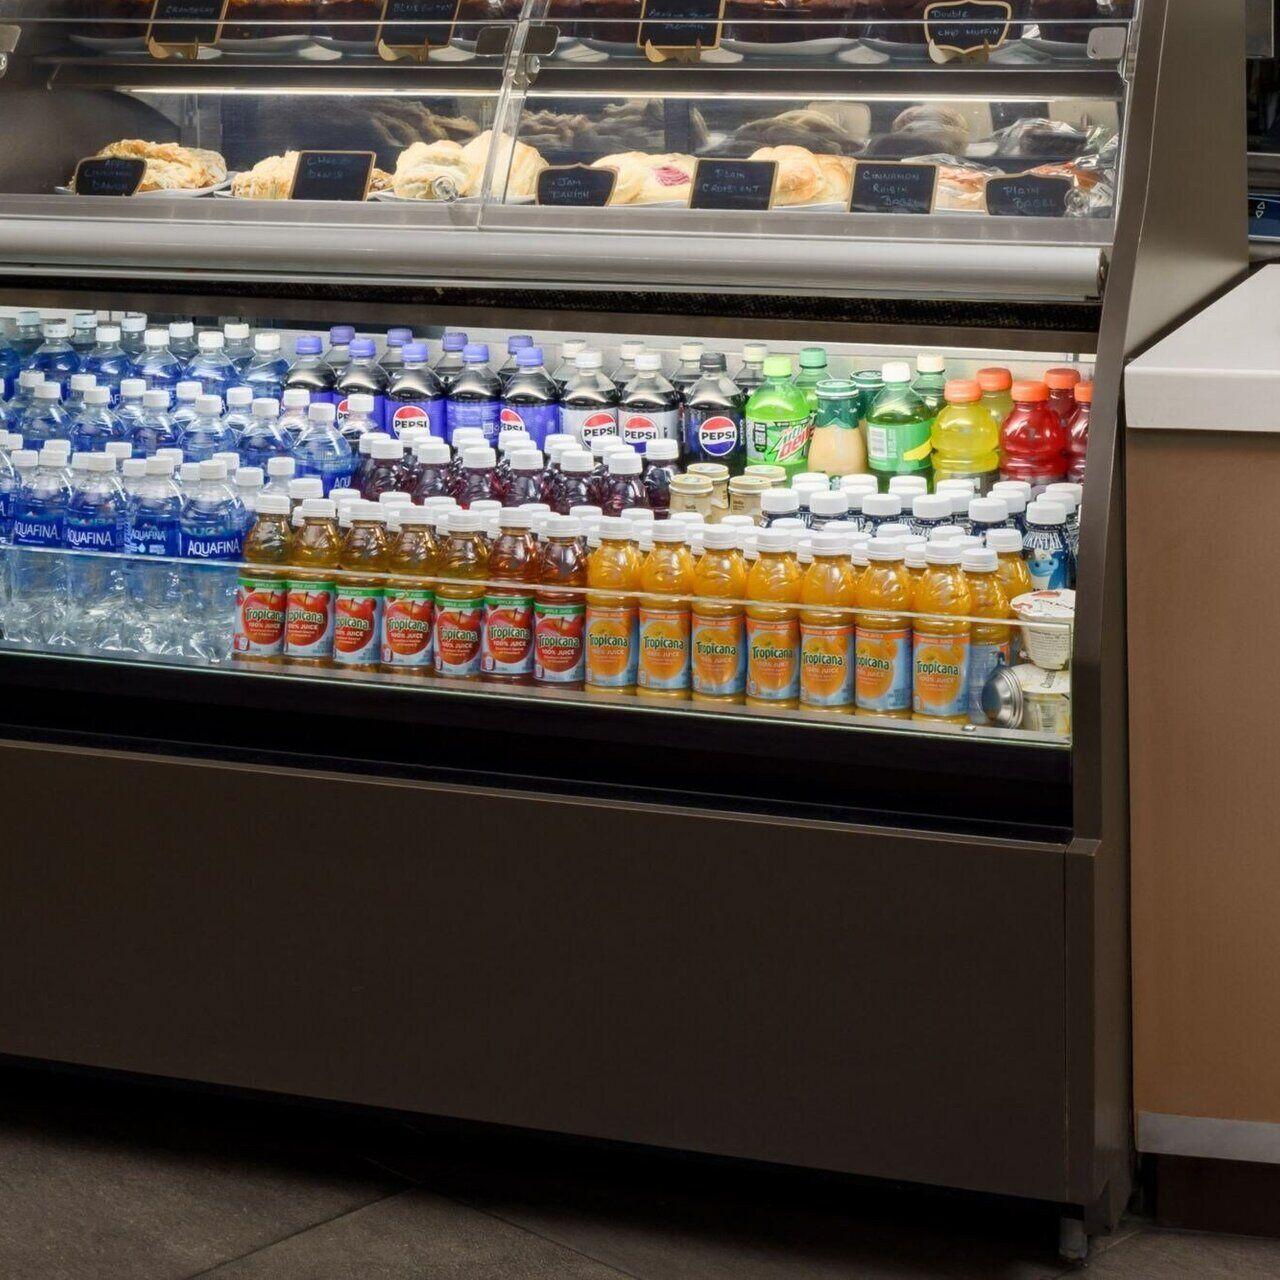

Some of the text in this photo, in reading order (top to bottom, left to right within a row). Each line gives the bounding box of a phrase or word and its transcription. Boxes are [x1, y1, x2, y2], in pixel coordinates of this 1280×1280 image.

[583, 426, 617, 437] PEPSI
[624, 430, 657, 440] PEPSI
[701, 430, 735, 440] PEPSI
[187, 538, 240, 557] AQUAFINA
[537, 634, 579, 648] Tropicana
[589, 633, 628, 647] Tropicana
[644, 636, 684, 650] Tropicana
[696, 641, 737, 655] Tropicana
[752, 646, 793, 660] Tropicana
[802, 651, 843, 665] Tropicana
[916, 660, 959, 675] Tropicana
